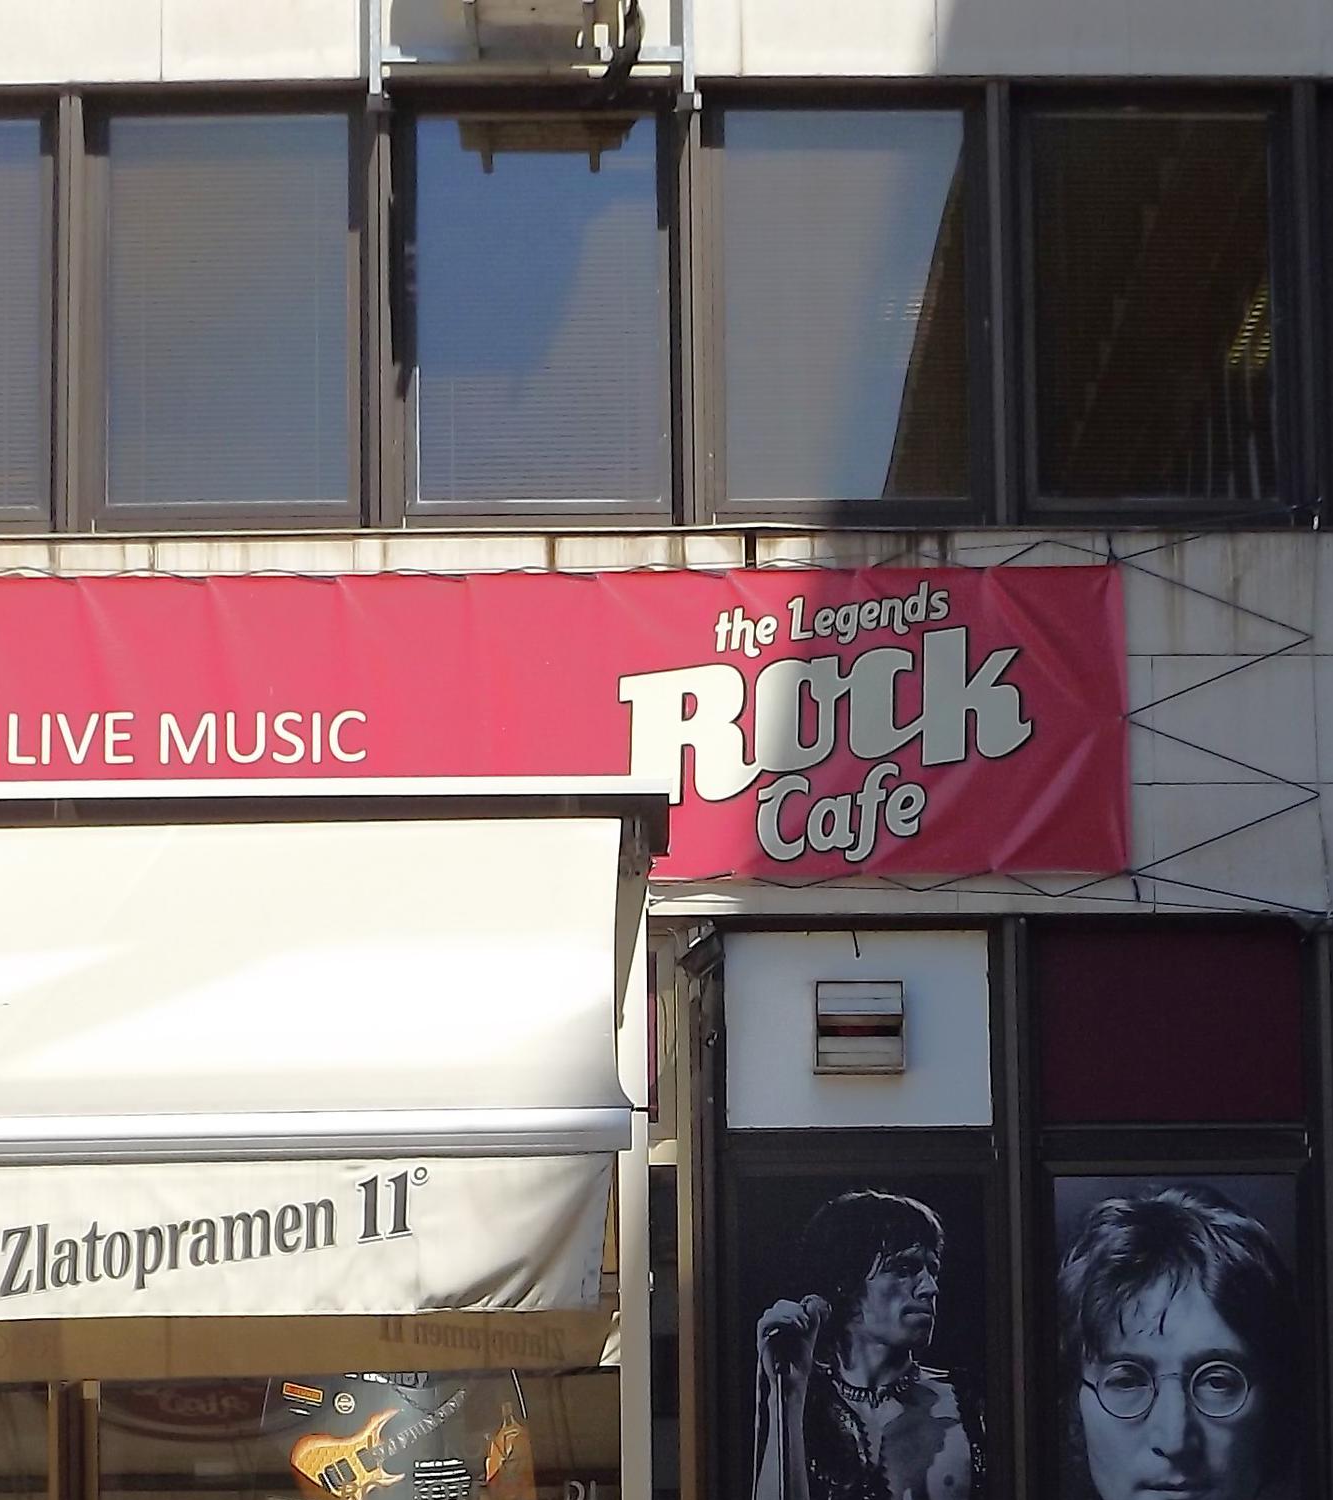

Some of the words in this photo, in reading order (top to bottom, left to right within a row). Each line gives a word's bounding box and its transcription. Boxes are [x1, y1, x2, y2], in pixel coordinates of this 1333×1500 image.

[715, 607, 778, 658] the
[787, 581, 949, 644] Legends
[6, 710, 135, 766] LIVE
[158, 709, 369, 765] MUSIC
[756, 762, 927, 863] Cafe
